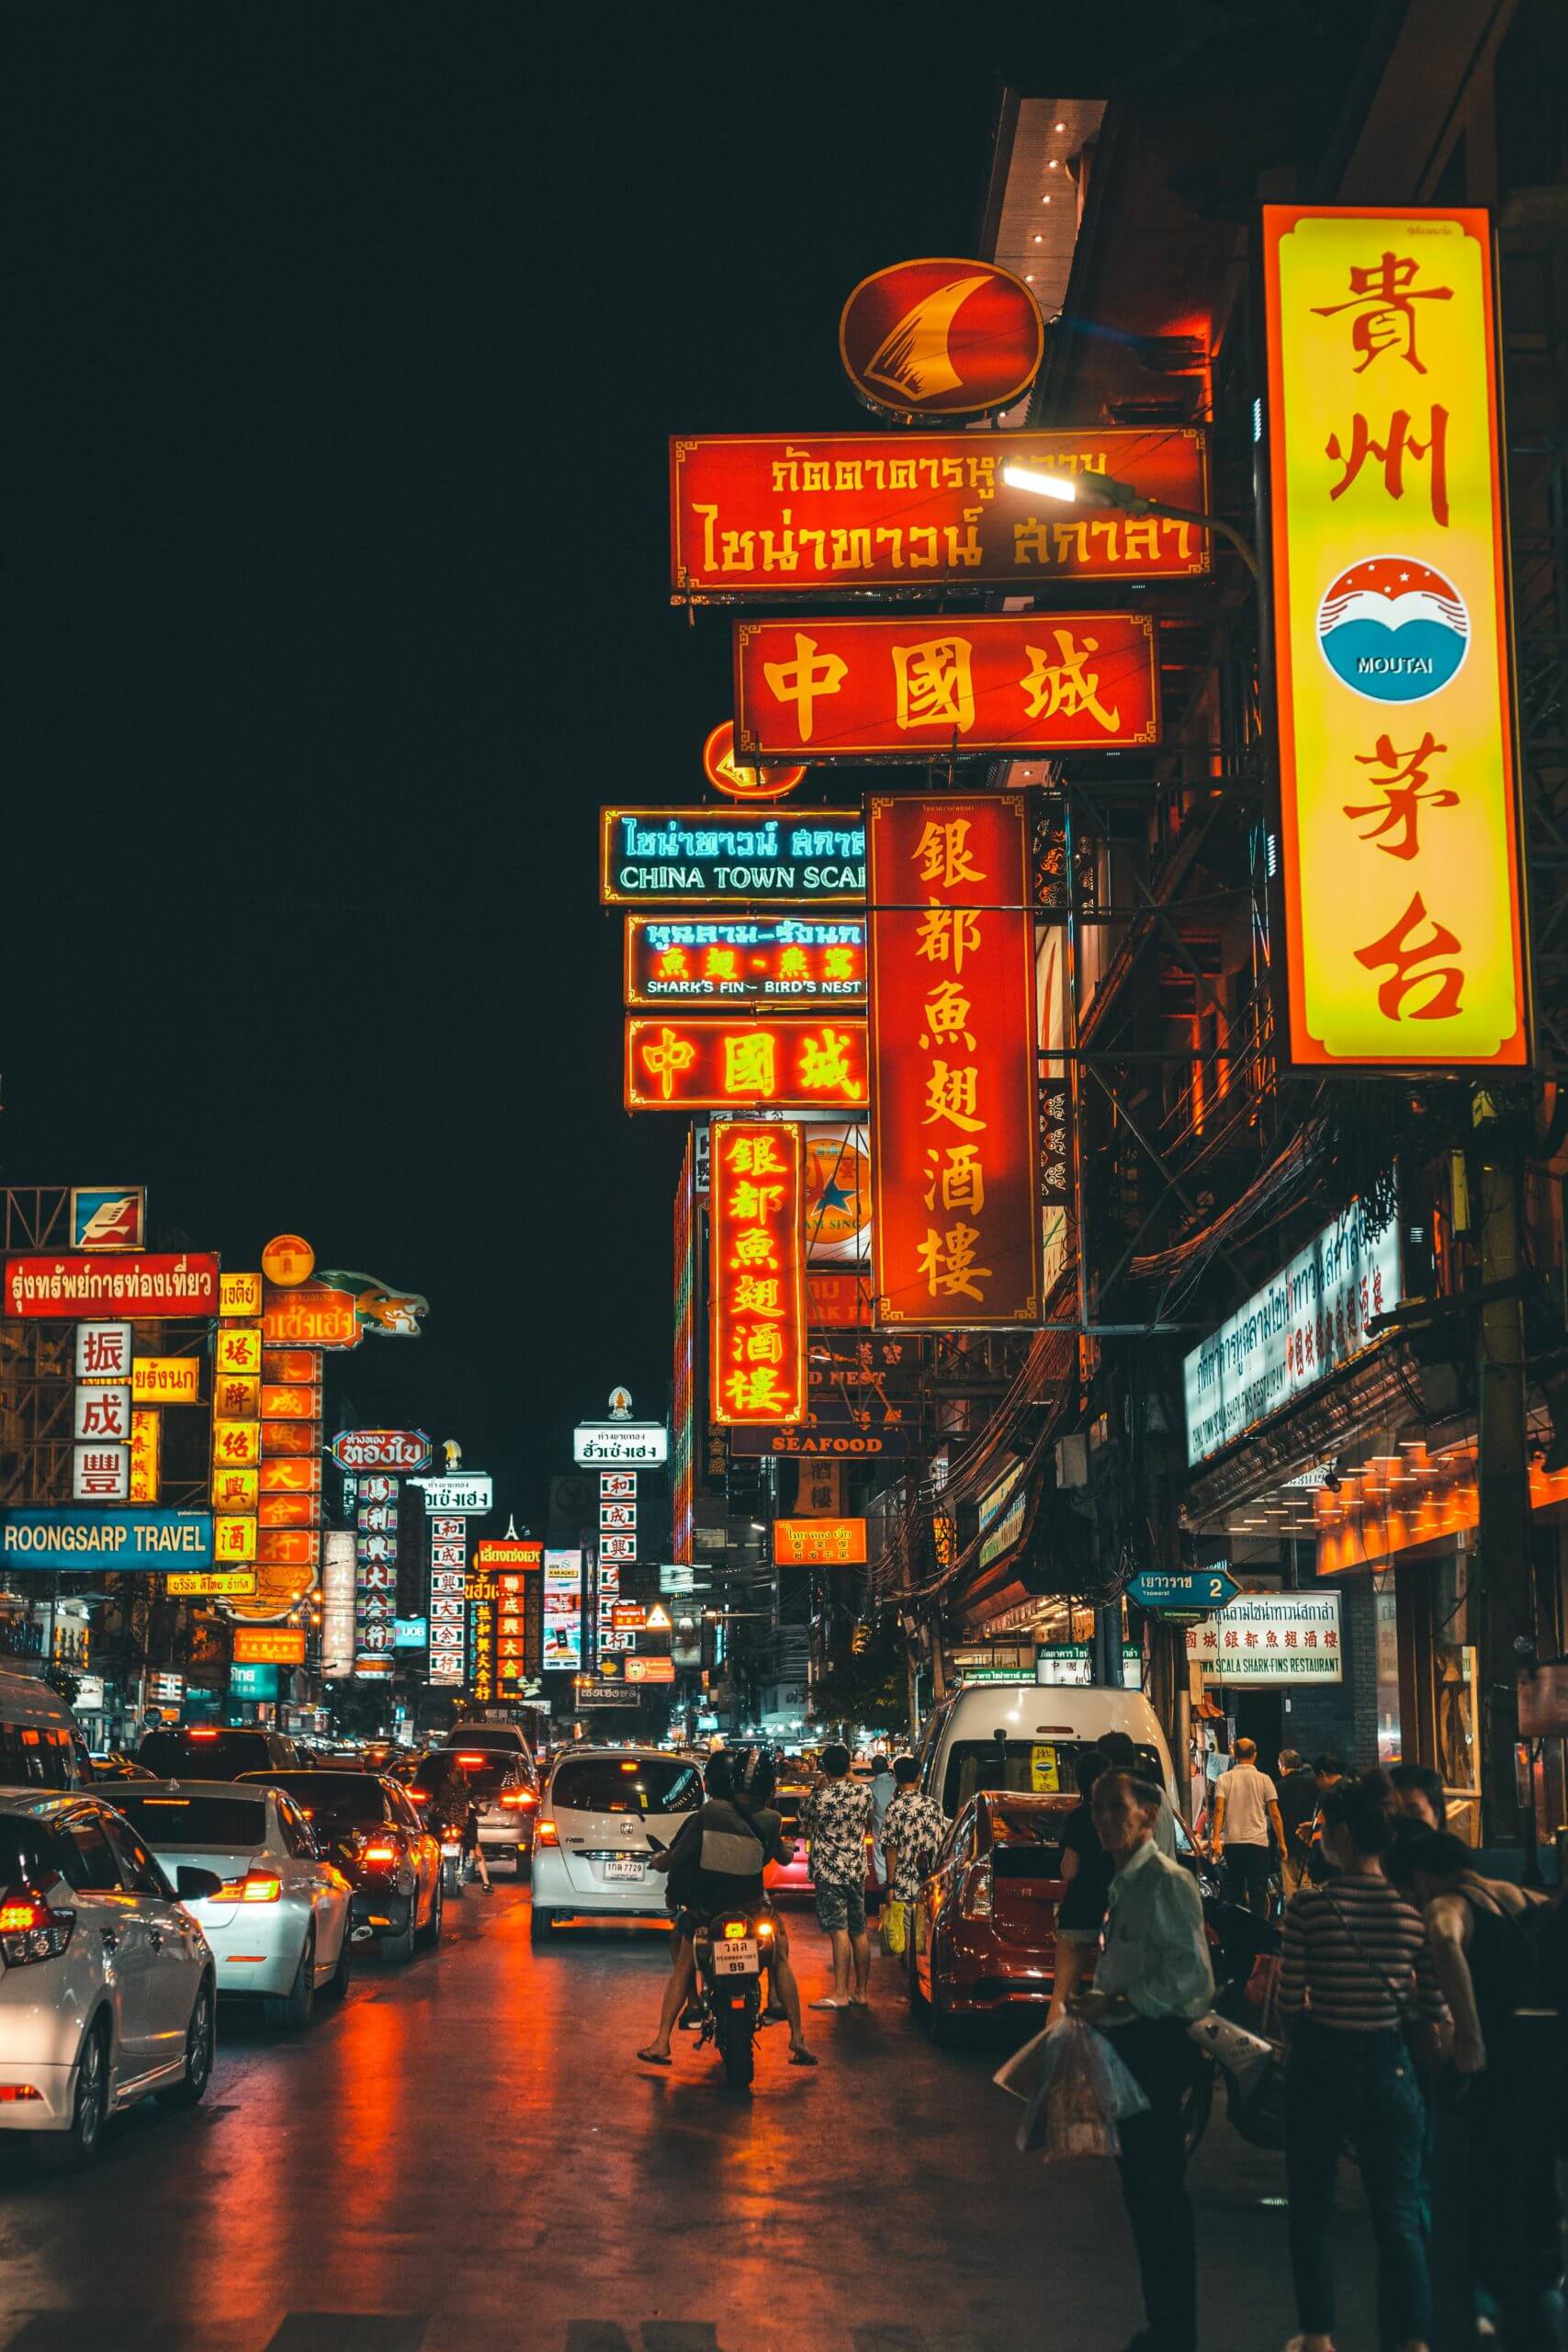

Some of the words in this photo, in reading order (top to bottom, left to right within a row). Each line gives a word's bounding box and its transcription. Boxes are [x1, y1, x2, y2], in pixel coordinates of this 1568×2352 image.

[1310, 251, 1454, 527] 貴州
[692, 503, 983, 571] ไชน่าทาวน์
[1357, 656, 1433, 673] MOUTAI
[763, 630, 1121, 742] 中國城
[622, 817, 779, 856] ไชน่าทาวน์
[620, 866, 705, 888] CHINA
[714, 866, 795, 888] TOWN
[1343, 732, 1464, 1022] 茅台
[647, 980, 714, 993] SHARK'S
[720, 981, 744, 993] FIN
[765, 981, 817, 993] BIRD'S
[821, 981, 862, 993] NEST
[643, 1028, 861, 1100] 中國城
[910, 819, 993, 1303] 銀都魚翅酒樓
[12, 1255, 211, 1313] รุ่งทรัพย์การท่องเที่ยว
[725, 1136, 790, 1413] 銀都魚翅酒樓
[81, 1331, 123, 1494] 振成豐
[344, 1436, 422, 1464] ทองใบ
[772, 1438, 882, 1452] SEAFOOD
[5, 1525, 128, 1552] ROONGSARP
[133, 1525, 207, 1552] TRAVEL
[1141, 1576, 1192, 1589] เยาวราช
[1209, 1578, 1223, 1598] 2
[401, 1627, 424, 1637] UOB
[1216, 1657, 1241, 1673] SCALA
[1243, 1657, 1288, 1674] SHARK-FINS
[1290, 1657, 1339, 1673] RESTAURANT
[624, 1863, 642, 1872] 7729
